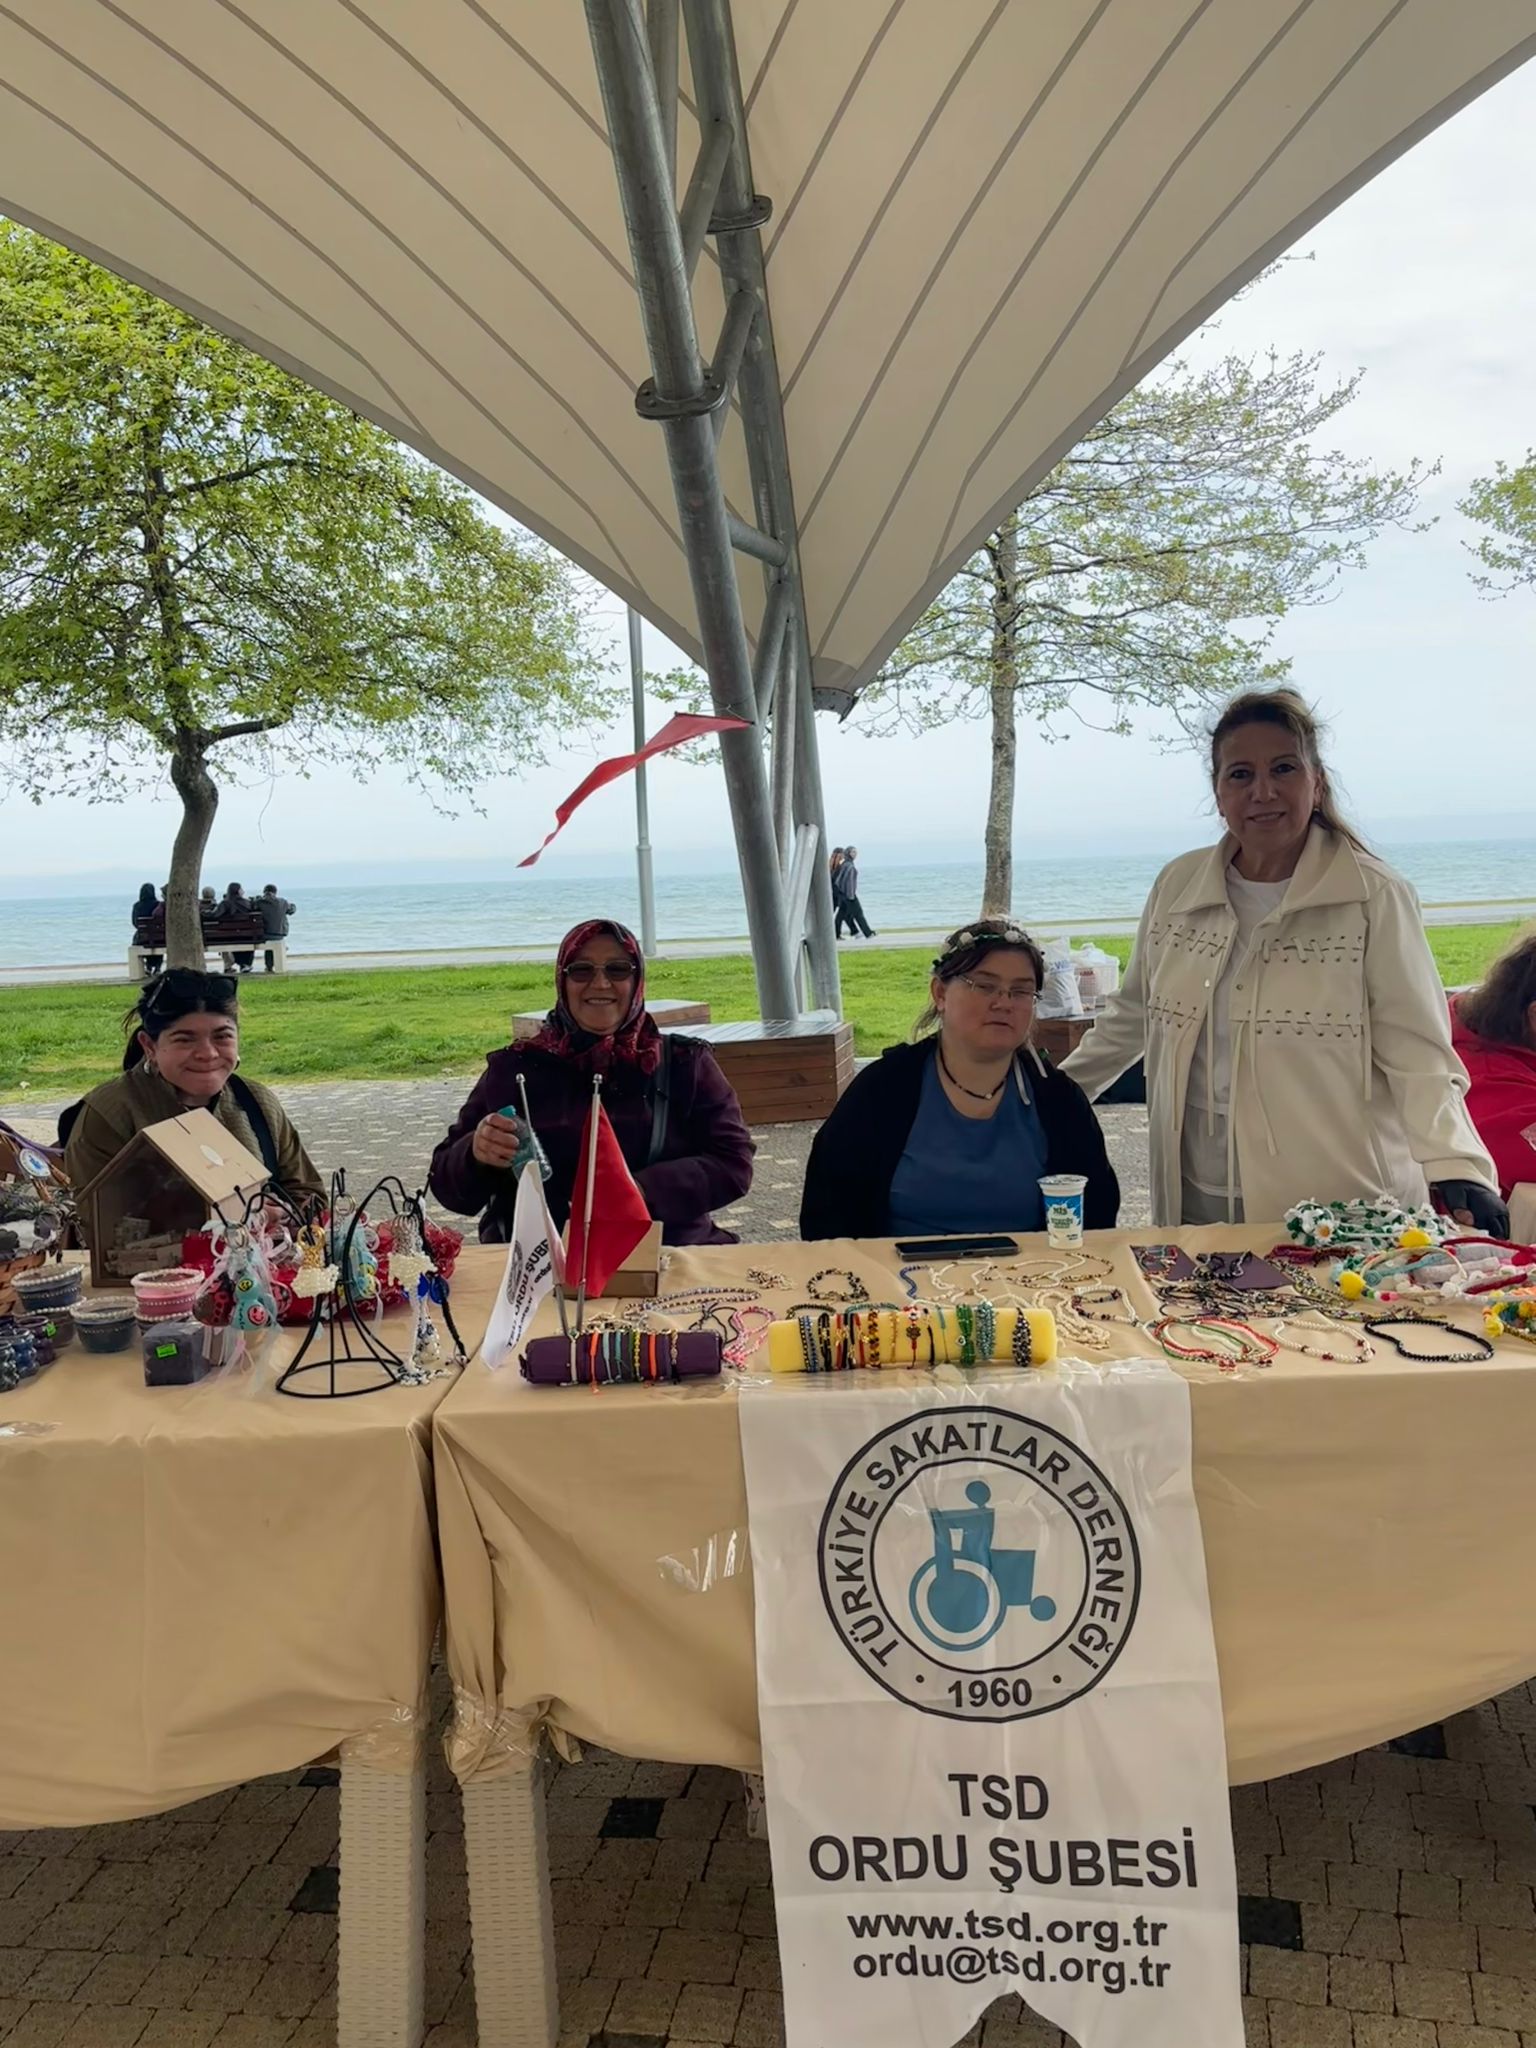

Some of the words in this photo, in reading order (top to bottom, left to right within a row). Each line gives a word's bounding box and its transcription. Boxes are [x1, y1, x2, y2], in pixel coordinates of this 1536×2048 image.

[828, 1490, 899, 1668] TÜRKİYE
[865, 1422, 1071, 1491] SAKATLAR
[1066, 1480, 1125, 1670] DERNEĞİ
[947, 1677, 1033, 1708] 1960
[947, 1773, 1049, 1821] TSD
[809, 1834, 968, 1883] ORDU
[988, 1826, 1198, 1894] ŞUBESİ
[846, 1909, 1168, 1953] www.tsd.org.tr
[853, 1944, 1171, 1994] ordu@tsd.org.tr
